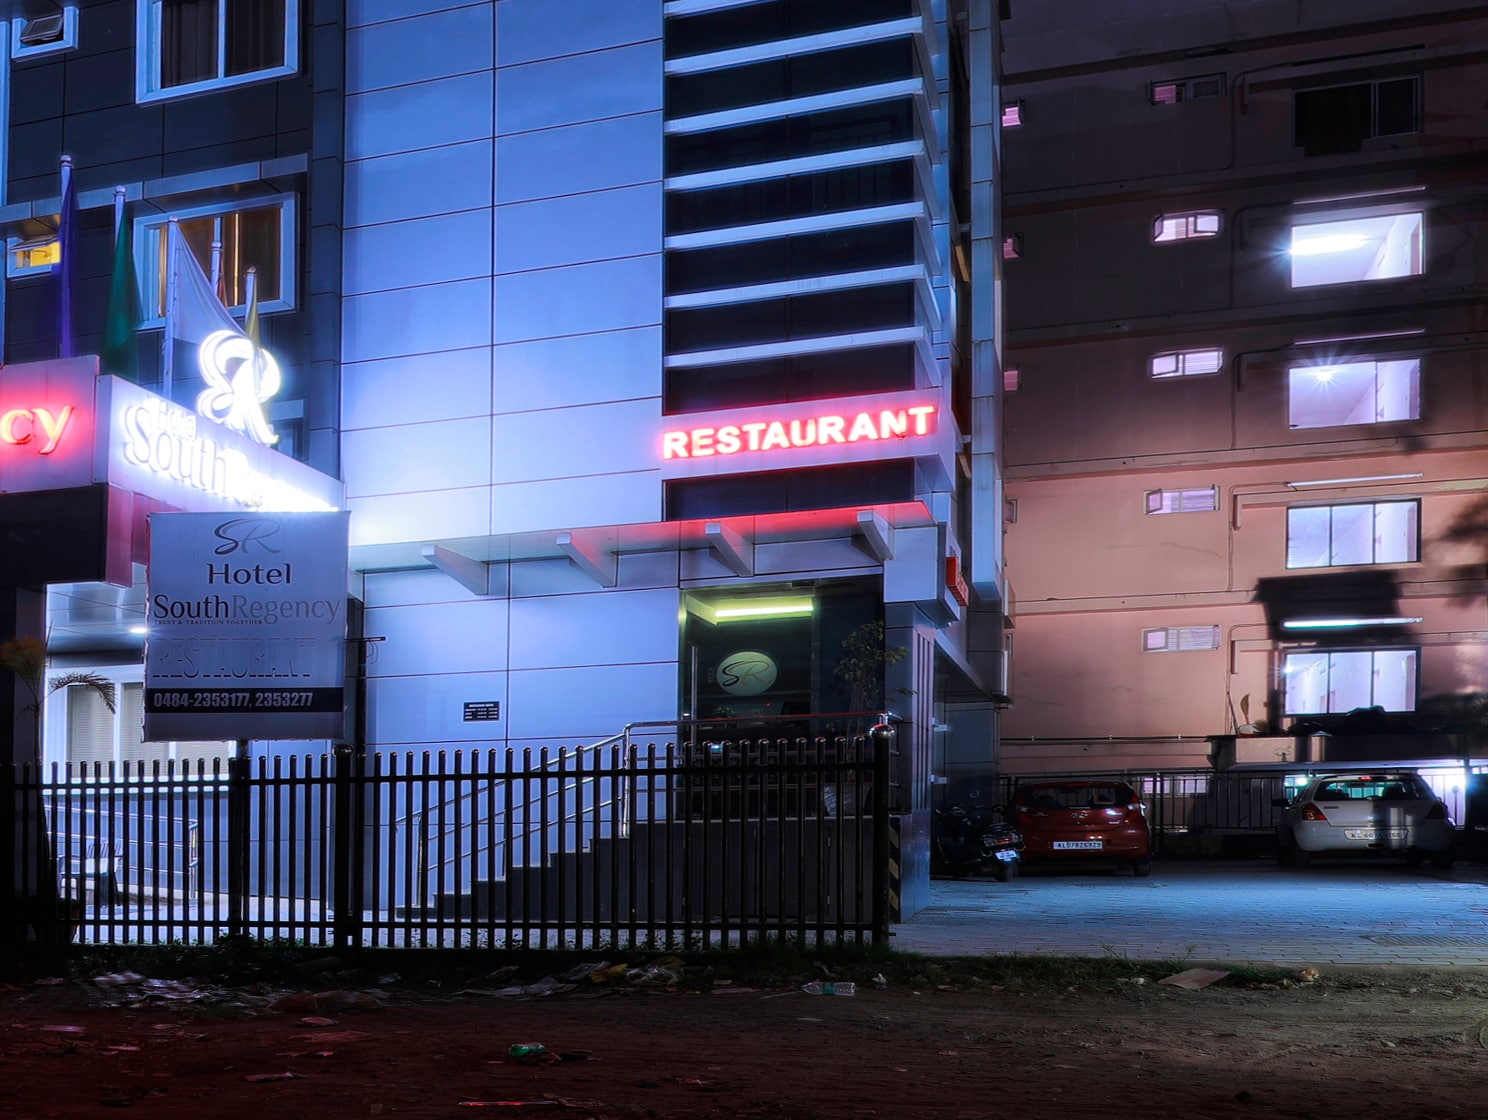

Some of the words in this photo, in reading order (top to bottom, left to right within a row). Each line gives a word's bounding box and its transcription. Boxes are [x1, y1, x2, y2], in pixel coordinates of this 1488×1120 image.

[662, 405, 935, 460] RESTAURANT
[206, 563, 292, 584] Hotel
[153, 692, 252, 708] 0484-2353177,
[255, 692, 313, 707] 2353277
